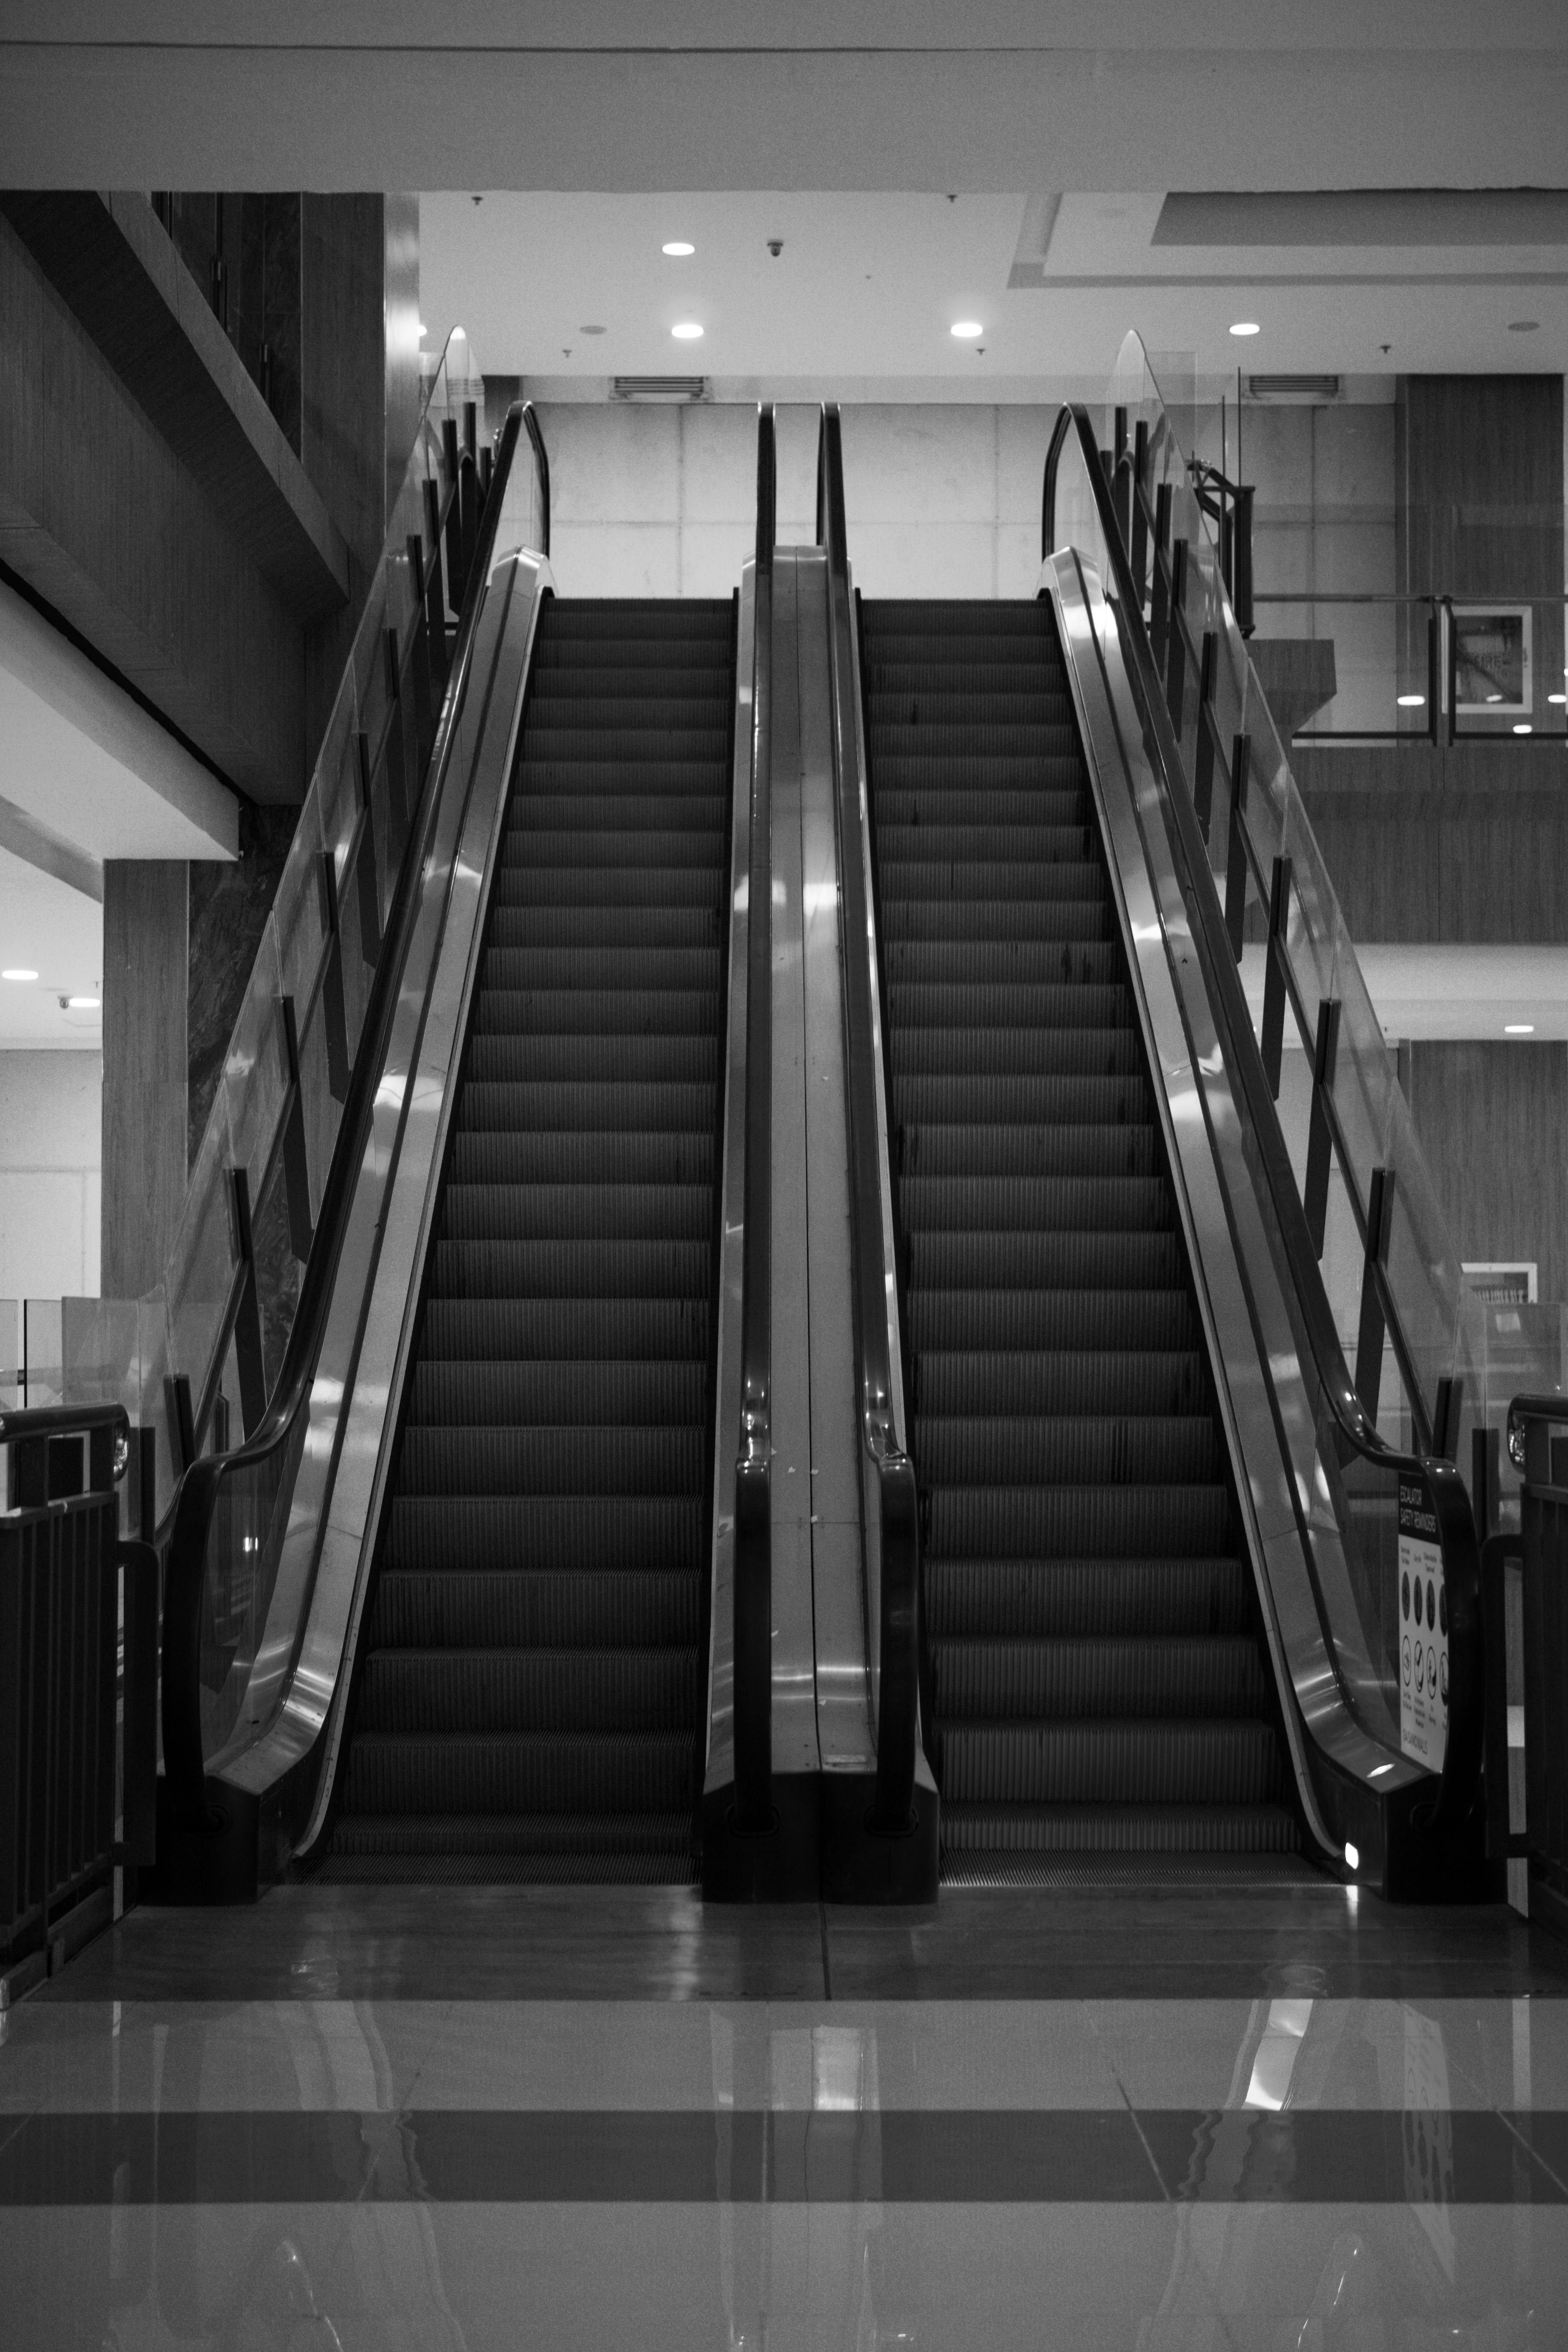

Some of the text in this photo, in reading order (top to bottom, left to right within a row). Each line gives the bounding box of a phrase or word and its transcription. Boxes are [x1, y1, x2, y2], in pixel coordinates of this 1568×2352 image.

[1400, 1485, 1422, 1506] ESCALATOR
[1400, 1507, 1436, 1533] SAFETY REMINDERS
